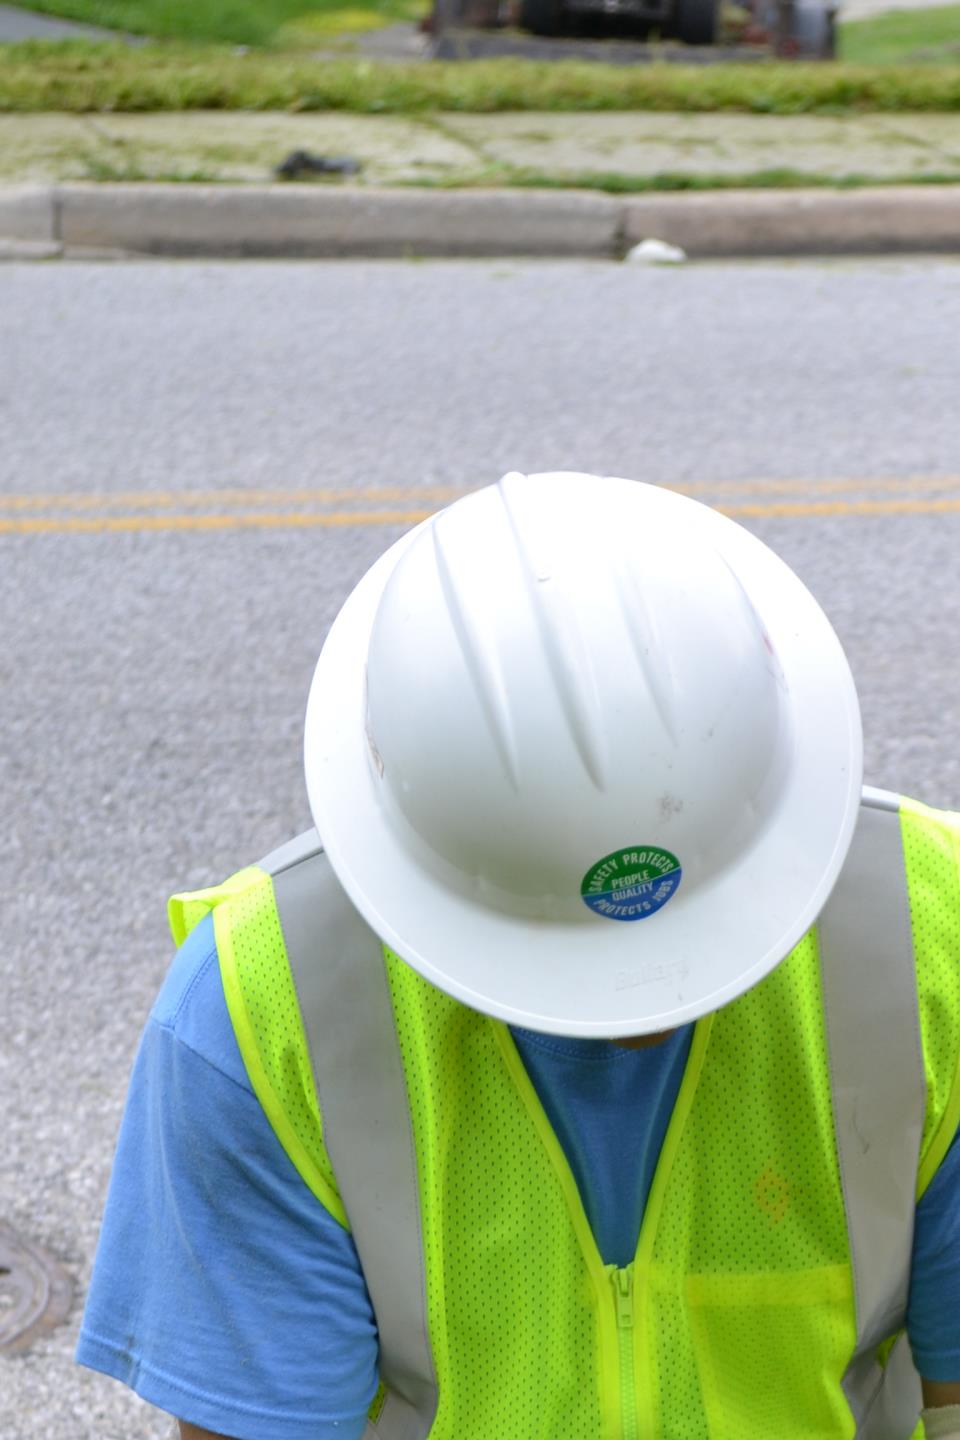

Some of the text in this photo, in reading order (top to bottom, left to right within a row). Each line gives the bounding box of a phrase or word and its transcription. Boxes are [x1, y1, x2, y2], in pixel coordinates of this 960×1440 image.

[588, 851, 674, 892] SAFETY PROTECTS
[611, 869, 650, 889] PEOPLE
[593, 880, 674, 916] PROTECTS JOBS
[612, 882, 653, 901] QUALITY
